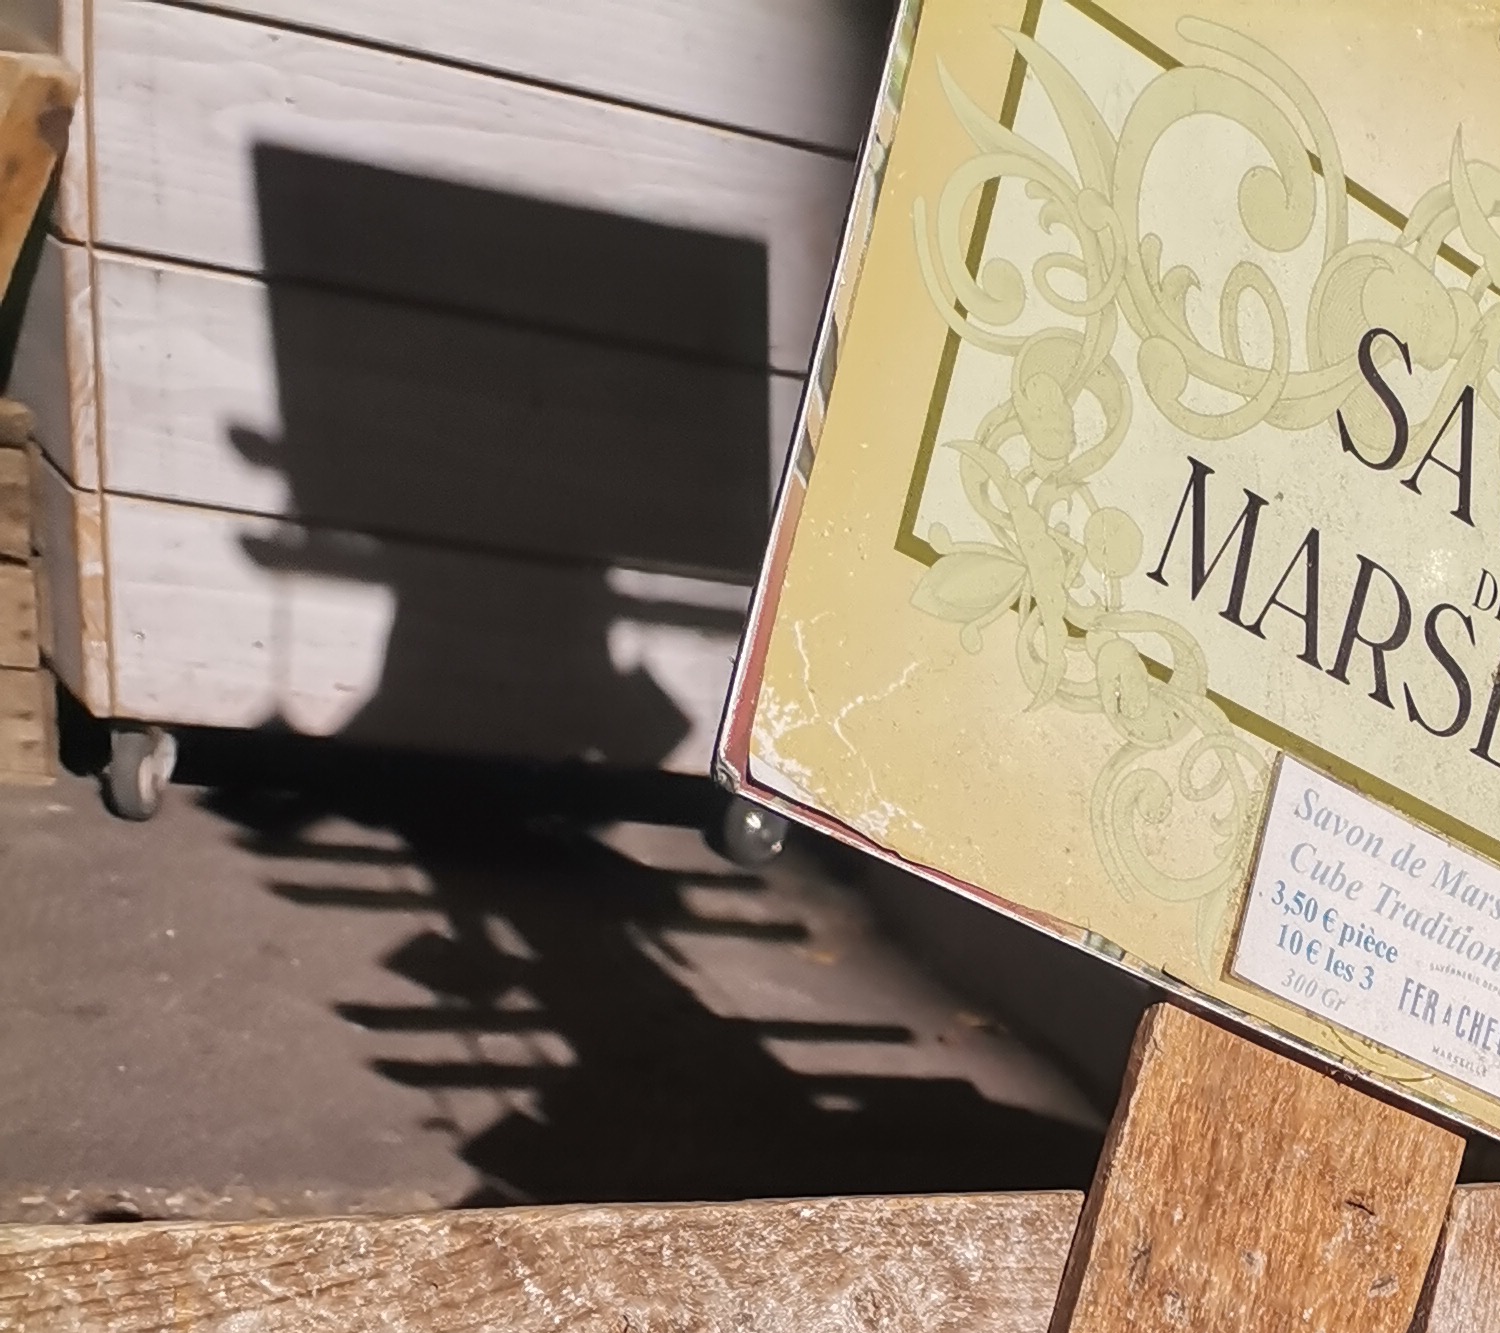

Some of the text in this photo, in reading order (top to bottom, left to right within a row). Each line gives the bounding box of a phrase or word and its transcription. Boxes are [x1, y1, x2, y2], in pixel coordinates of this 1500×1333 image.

[1294, 787, 1384, 859] Savon
[1390, 843, 1427, 879] de
[1290, 841, 1364, 901] Cube
[1270, 879, 1400, 964] 3,50 € pièce
[1276, 924, 1376, 991] 10 € les 3
[1281, 968, 1346, 1013] 300 Gr
[1398, 976, 1439, 1026] FER
[1432, 1045, 1488, 1077] MARSEILLE
